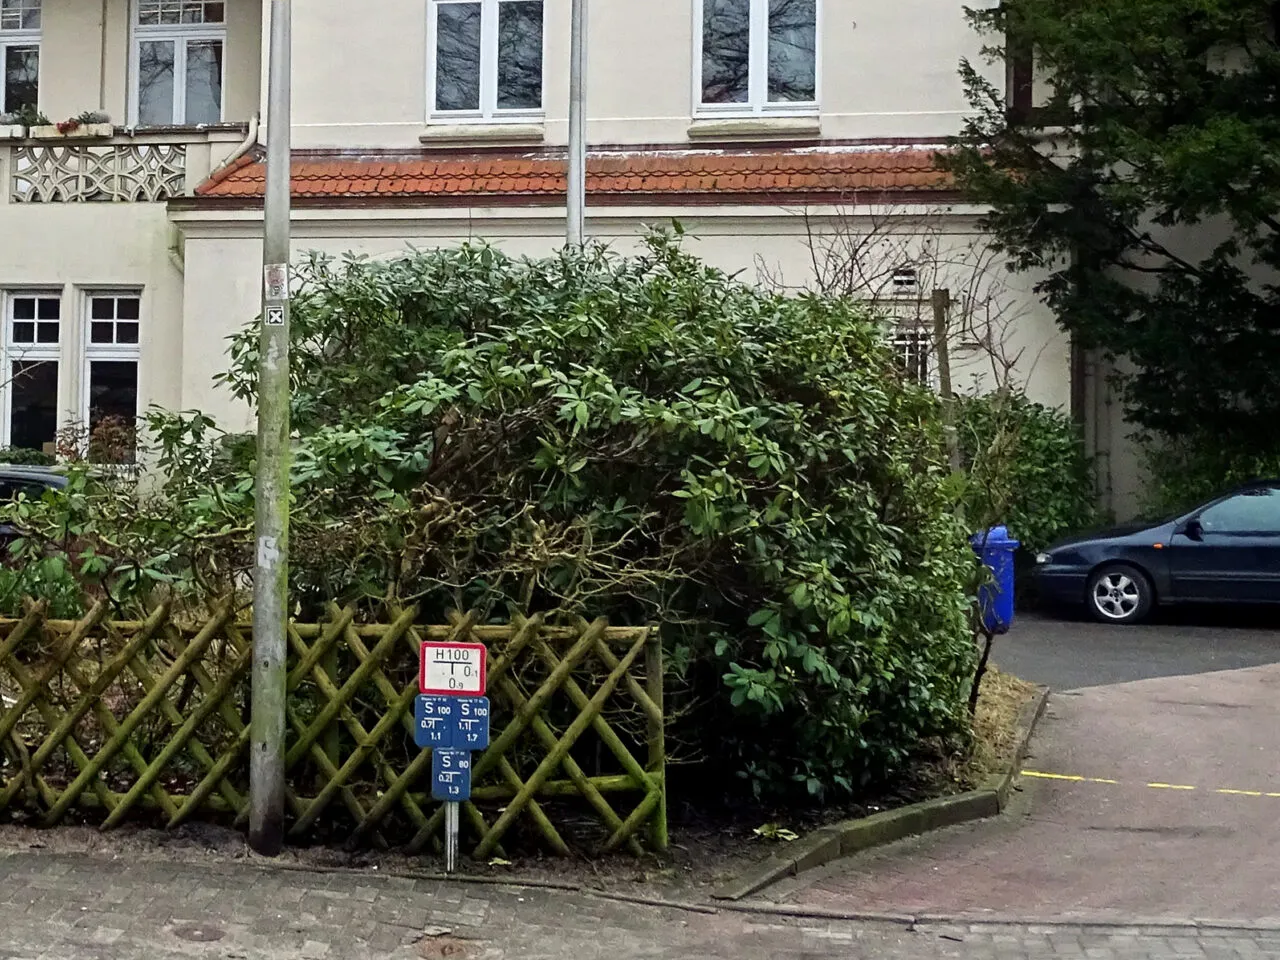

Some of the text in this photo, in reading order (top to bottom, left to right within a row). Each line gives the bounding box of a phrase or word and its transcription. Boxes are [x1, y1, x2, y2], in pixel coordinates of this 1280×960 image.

[424, 701, 451, 715] S 100
[461, 703, 487, 716] S 100
[442, 755, 451, 768] S
